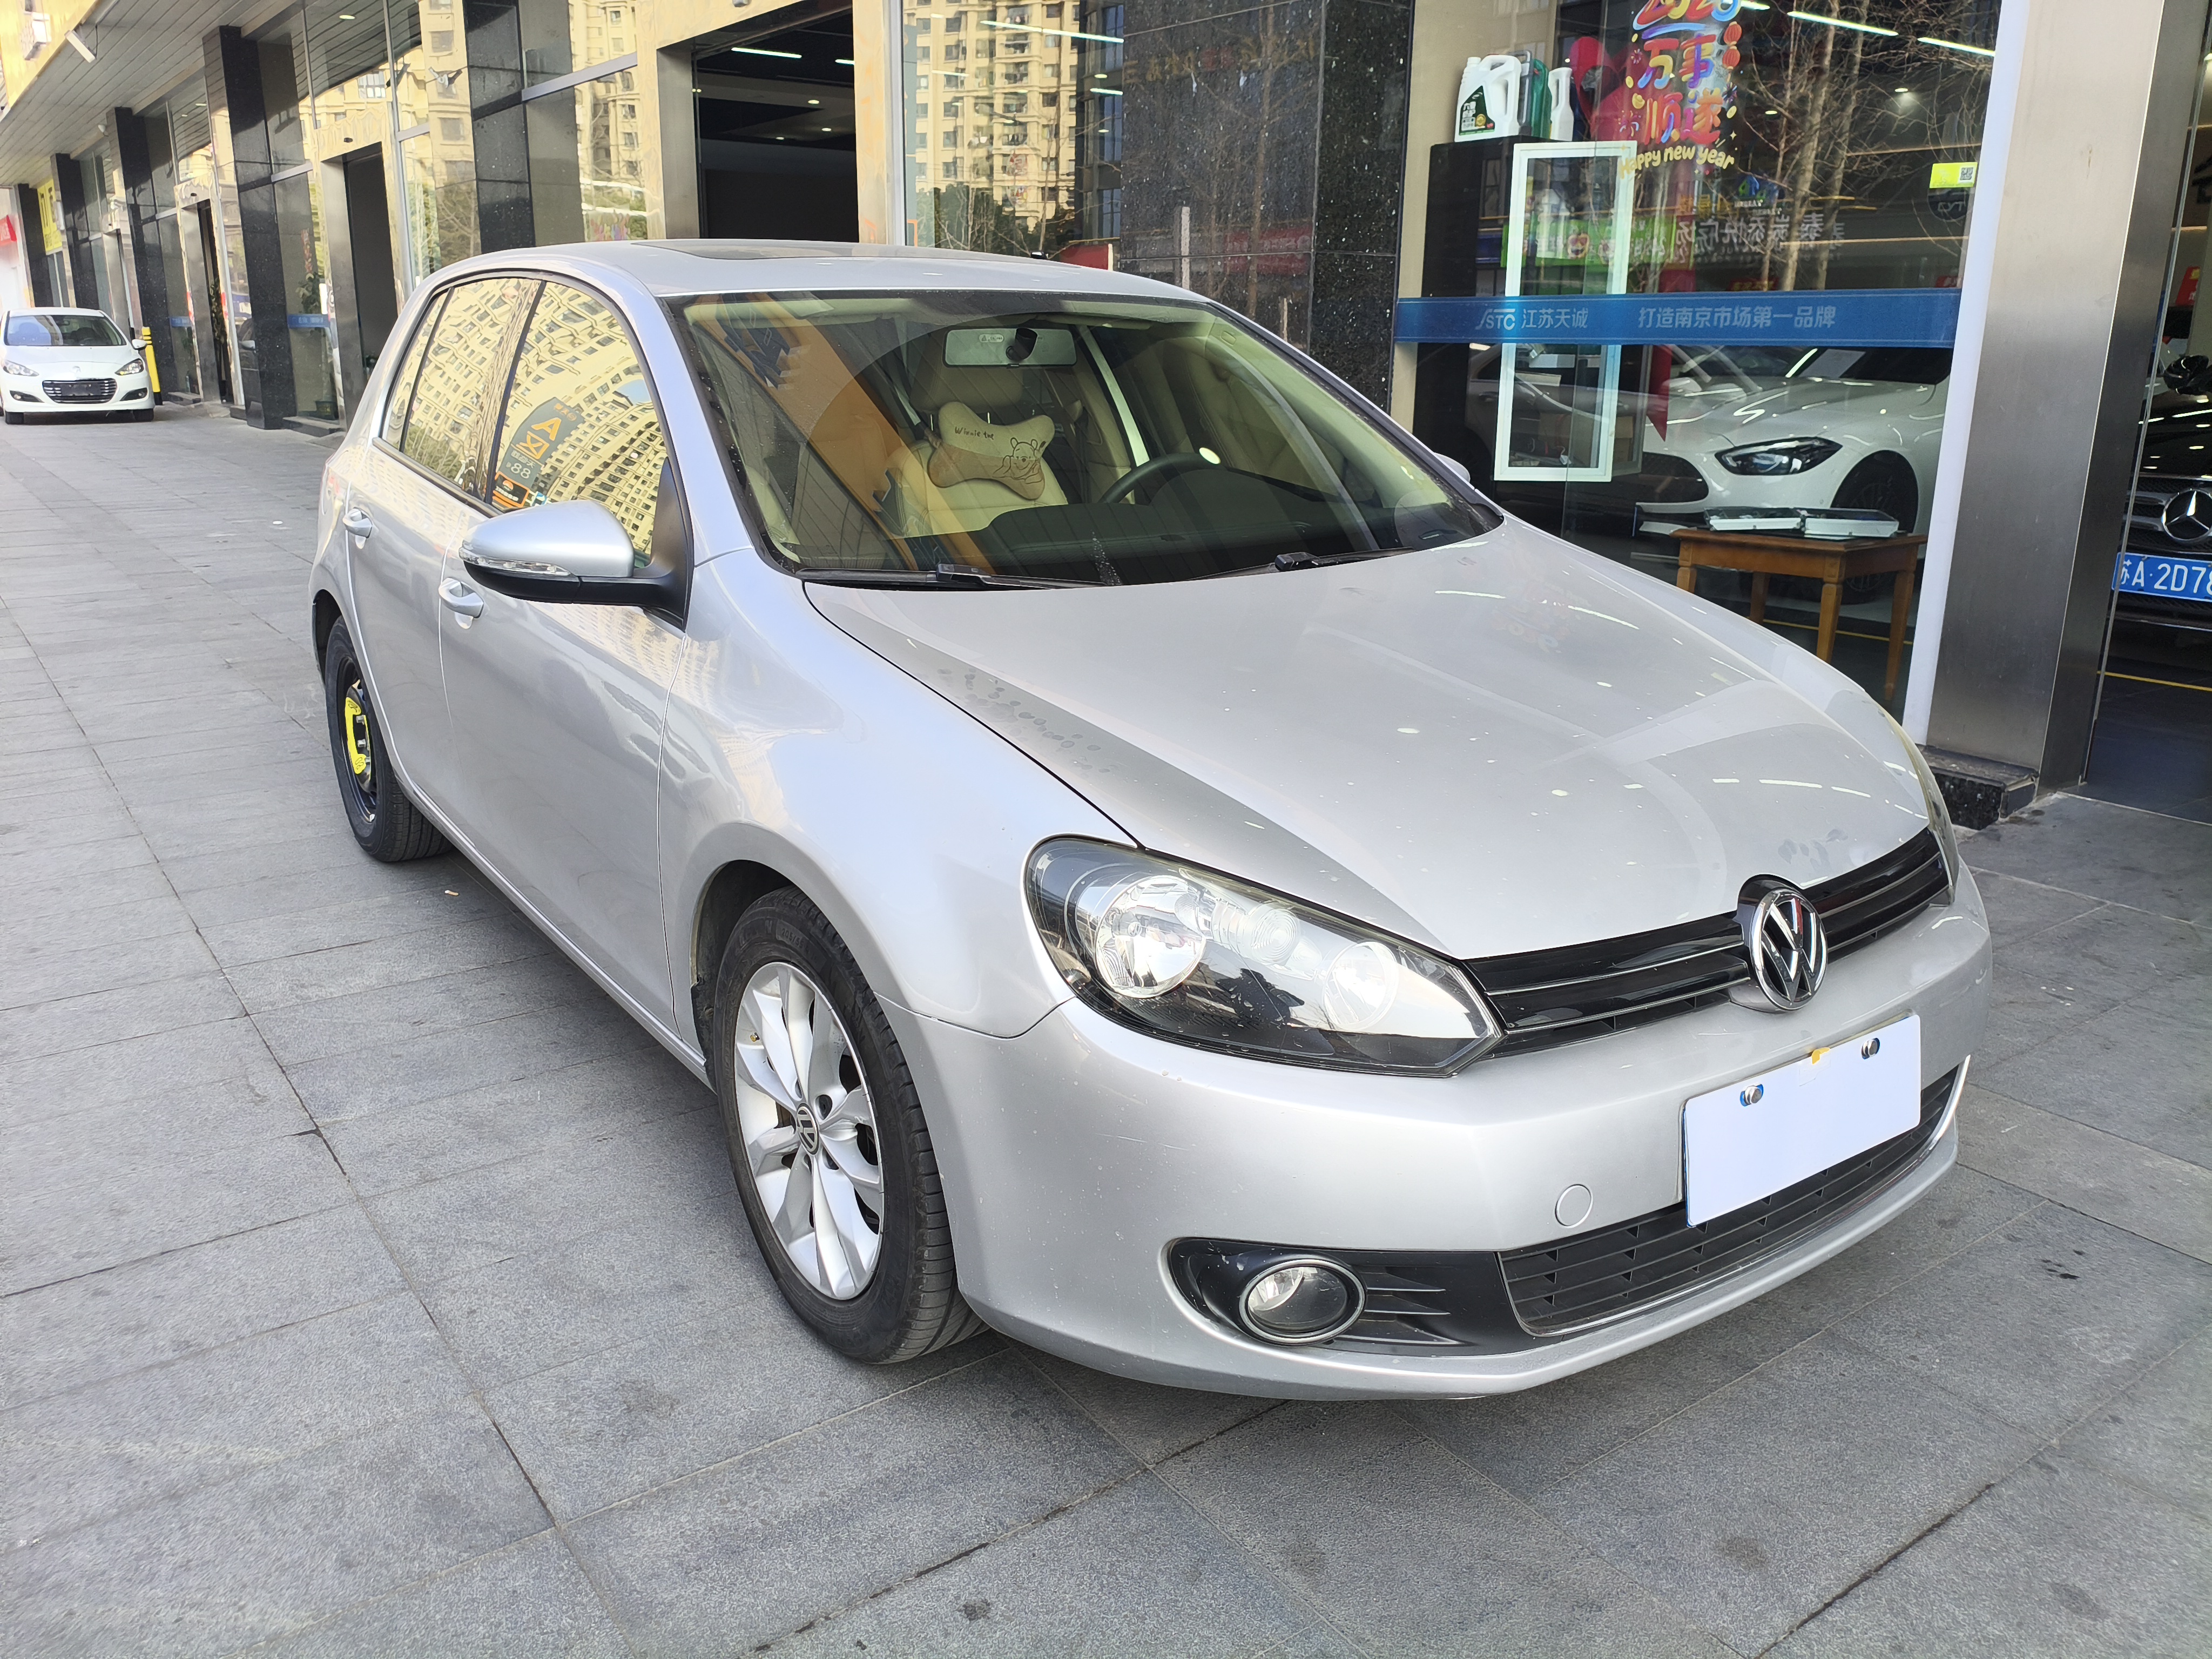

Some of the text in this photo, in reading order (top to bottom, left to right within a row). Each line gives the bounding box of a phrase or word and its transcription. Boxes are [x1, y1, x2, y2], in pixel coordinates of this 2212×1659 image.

[1637, 33, 1717, 89] 万事
[1643, 87, 1724, 145] 顺遂
[1620, 145, 1735, 179] Happy new year
[1521, 307, 1589, 329] 江苏天诚
[1638, 305, 1837, 329] 打造南京市场第一品牌
[954, 426, 981, 437] Winnie
